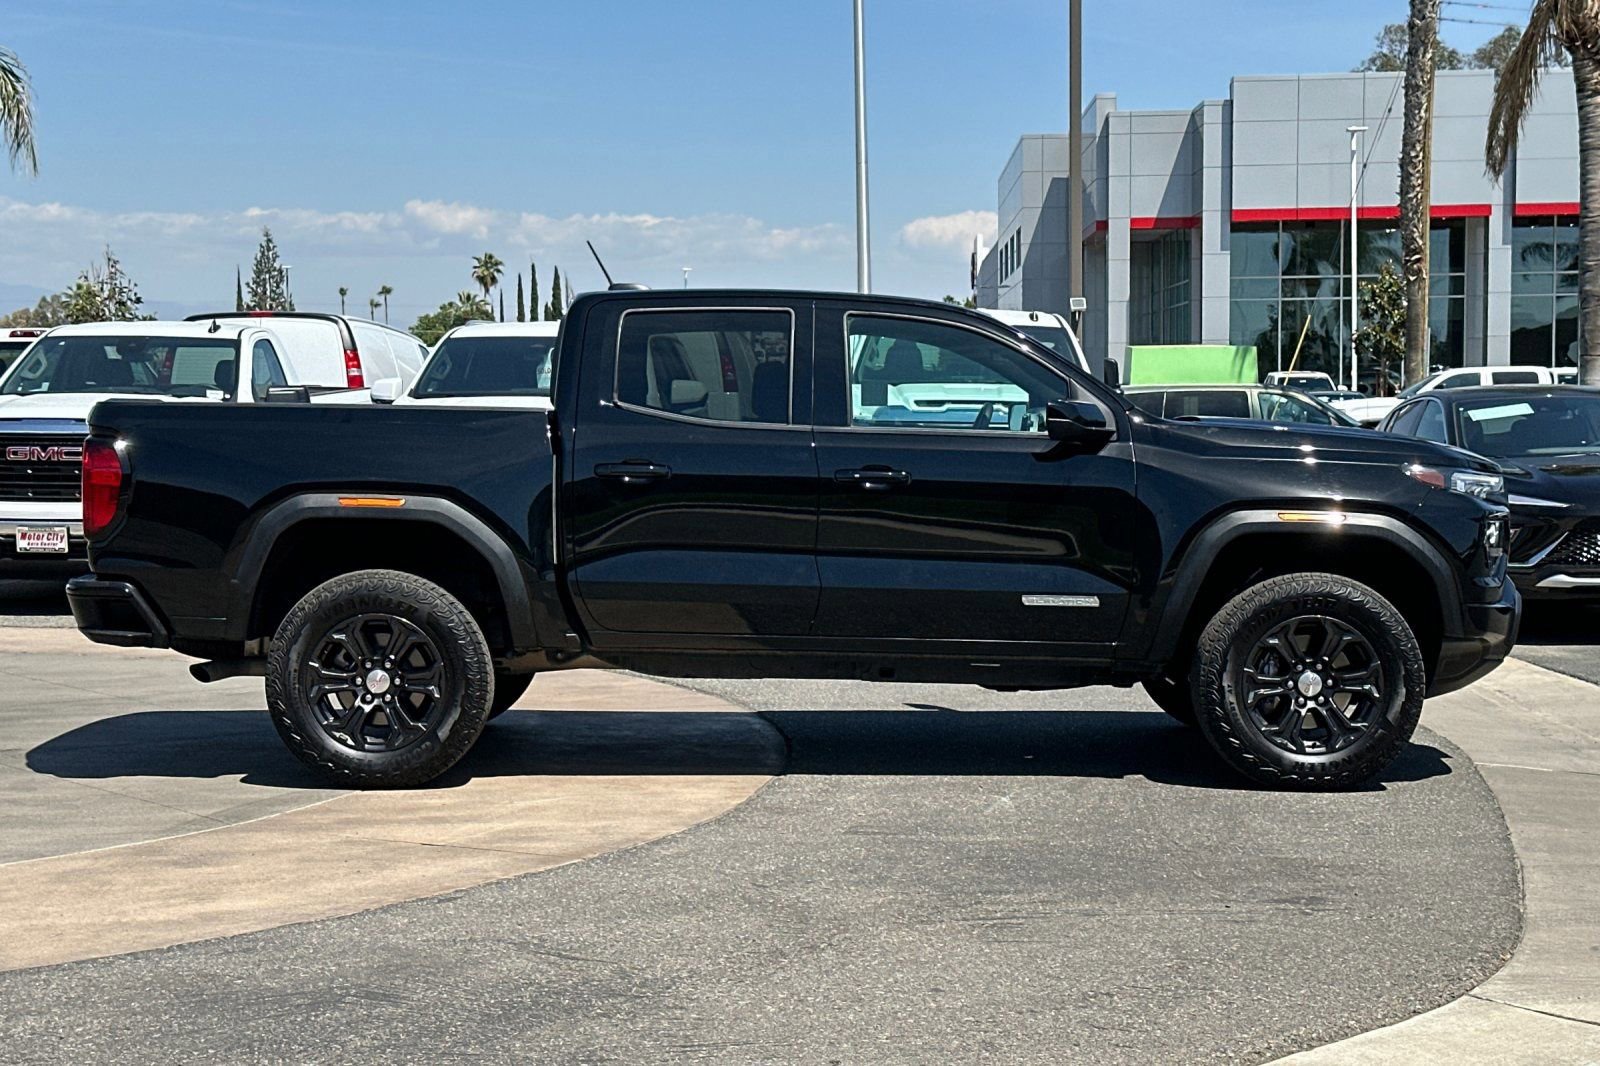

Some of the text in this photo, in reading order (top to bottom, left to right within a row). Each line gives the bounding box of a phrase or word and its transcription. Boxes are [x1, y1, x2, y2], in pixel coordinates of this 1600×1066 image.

[6, 446, 83, 461] GMC
[20, 531, 65, 544] Motor City
